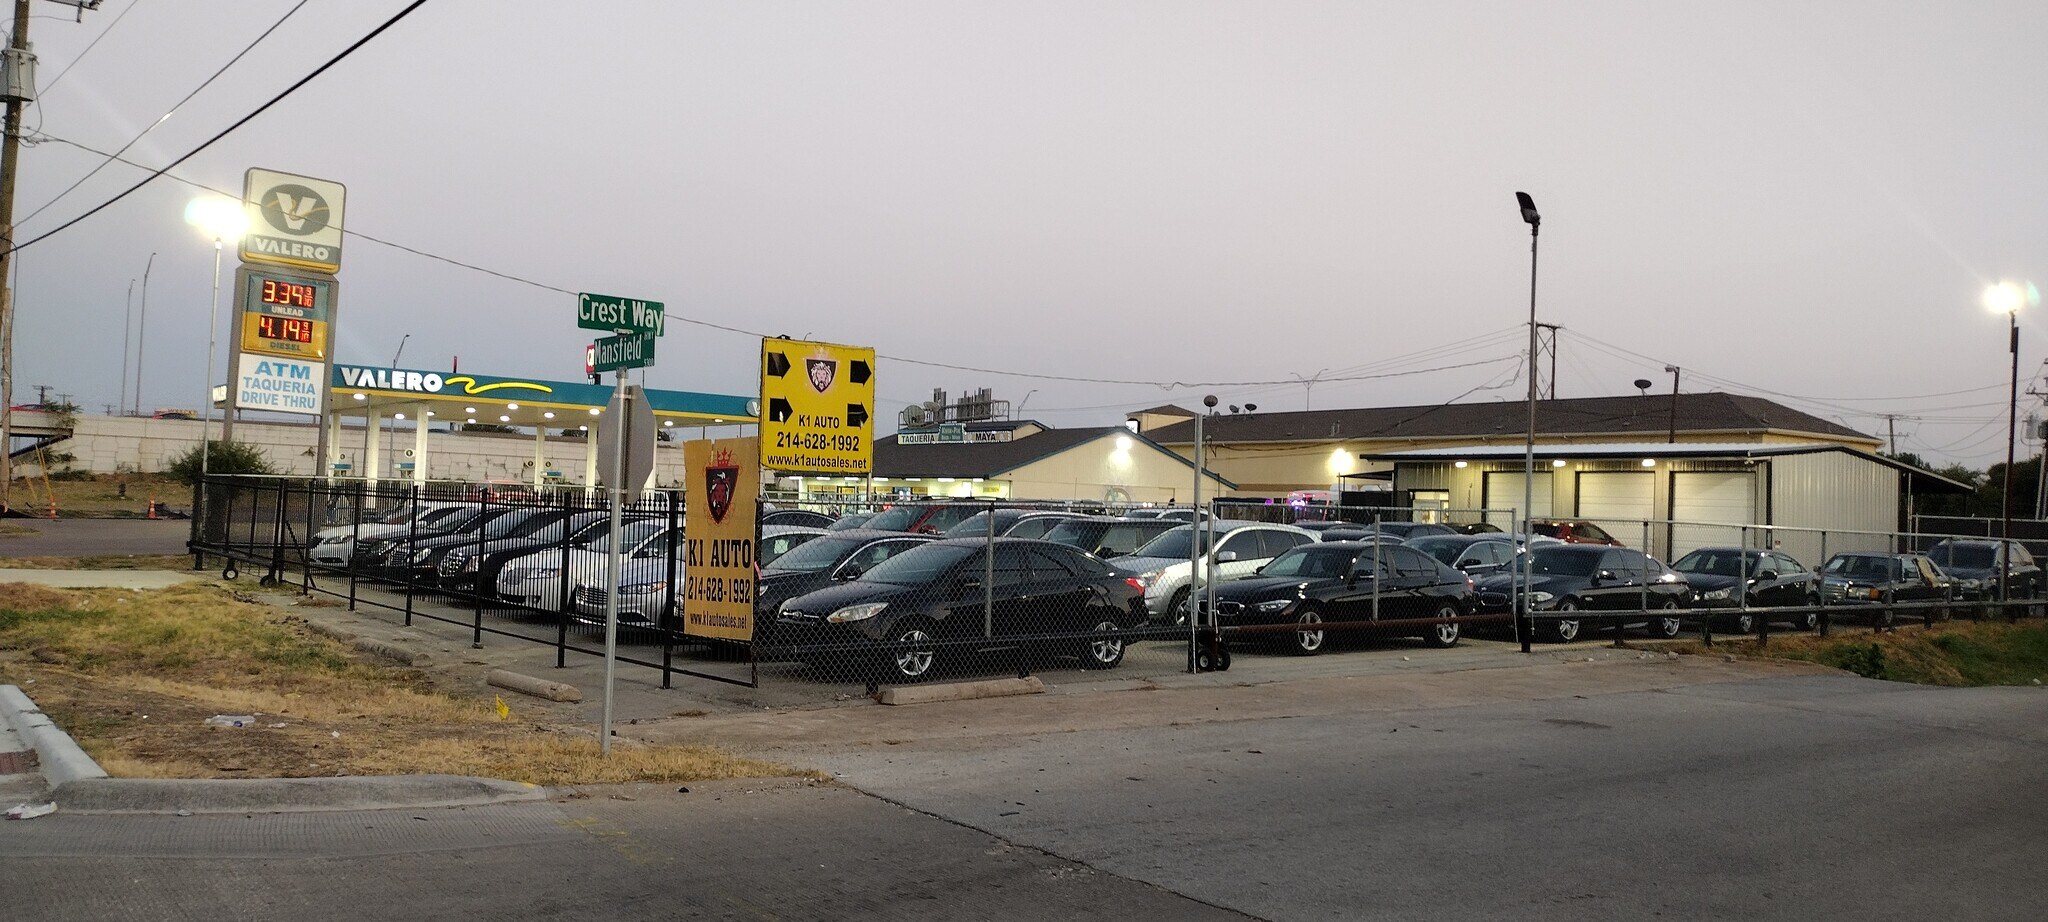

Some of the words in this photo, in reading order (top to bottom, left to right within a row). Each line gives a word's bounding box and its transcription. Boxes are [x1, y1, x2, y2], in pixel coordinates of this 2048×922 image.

[255, 237, 329, 261] VALERO
[271, 305, 304, 317] UNLEAD
[579, 293, 627, 325] Crest
[631, 300, 664, 336] Way
[270, 341, 301, 351] DIESEL
[594, 332, 642, 366] Mansfield
[254, 360, 311, 380] ATM
[340, 367, 443, 393] VALERO
[243, 376, 316, 395] TAQUERIA
[241, 390, 279, 406] DRIVE
[282, 394, 316, 409] THRU
[798, 414, 812, 427] K1
[814, 415, 841, 429] AUTO
[776, 431, 861, 452] 214-628-1992
[902, 434, 935, 443] TAQUERIA
[975, 433, 997, 441] MAYA
[767, 453, 868, 469] www.k1autosales.net
[710, 538, 752, 569] AUTO
[688, 575, 751, 604] 214-628-1992
